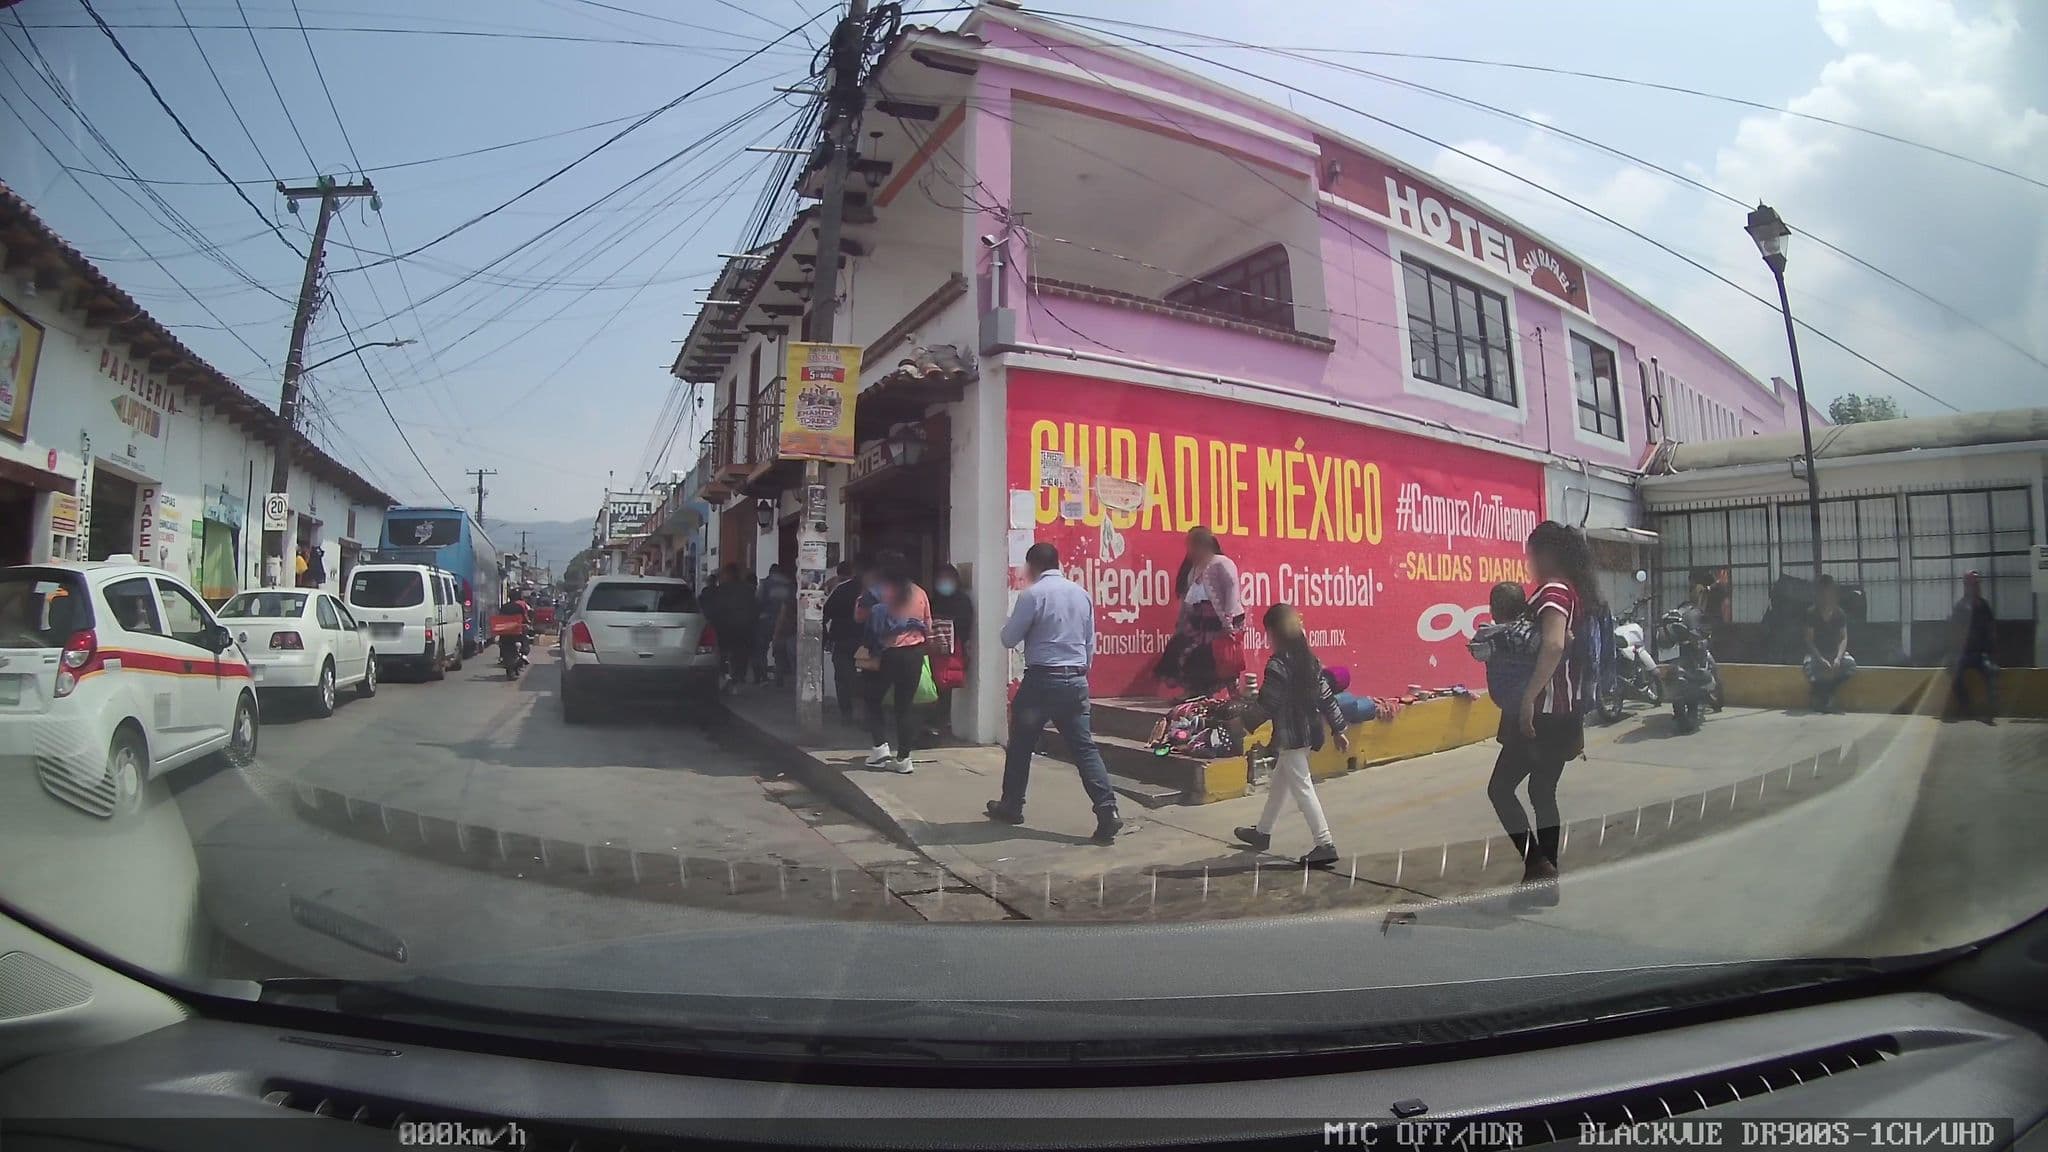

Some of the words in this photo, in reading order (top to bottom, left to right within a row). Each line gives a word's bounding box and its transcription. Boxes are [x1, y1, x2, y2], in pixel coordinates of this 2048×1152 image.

[1385, 176, 1528, 277] HOTEL
[99, 348, 177, 416] PAPELERIA
[809, 371, 817, 380] 5
[850, 445, 887, 481] HOTEL
[1030, 419, 1201, 534] CIUDAD
[1209, 440, 1249, 536] DE
[1257, 436, 1383, 545] MÉXICO
[271, 500, 284, 514] 20
[610, 503, 651, 514] HOTEL
[1061, 558, 1170, 607] aliendo
[1240, 571, 1271, 607] an
[1278, 562, 1374, 607] Cristóbal
[1095, 628, 1154, 655] Consulta
